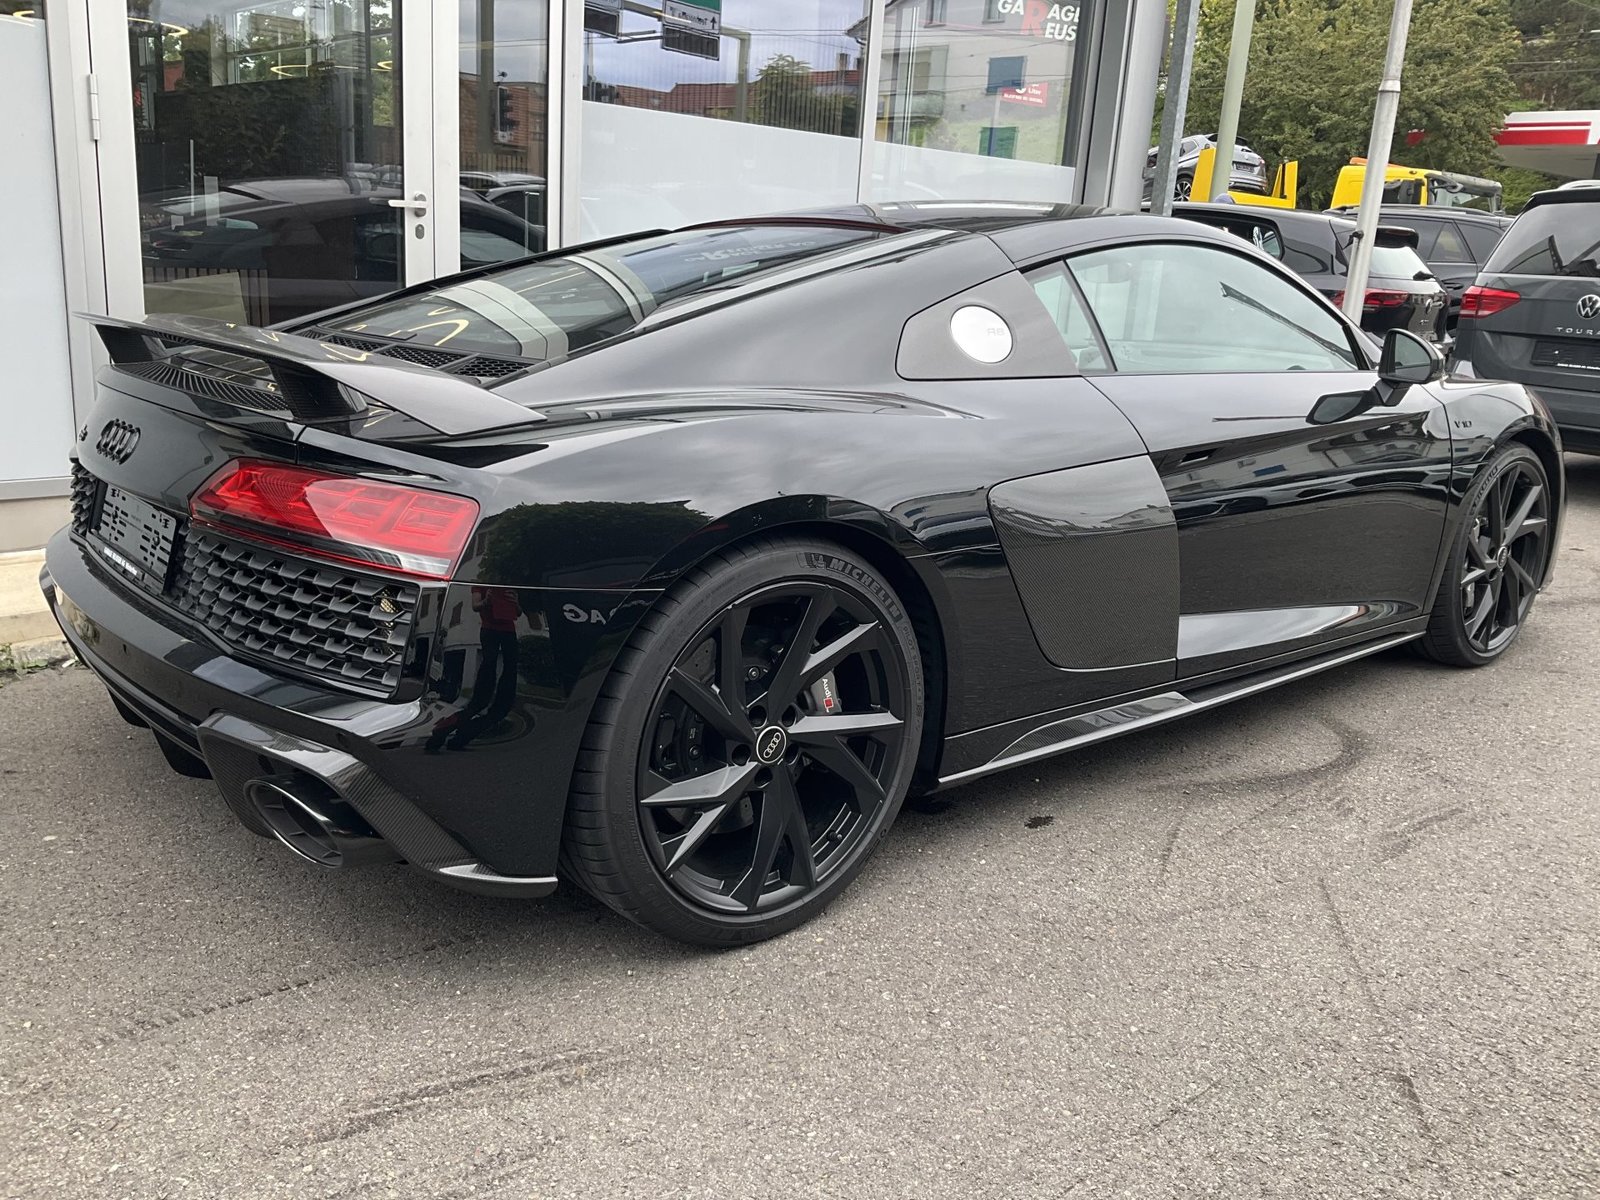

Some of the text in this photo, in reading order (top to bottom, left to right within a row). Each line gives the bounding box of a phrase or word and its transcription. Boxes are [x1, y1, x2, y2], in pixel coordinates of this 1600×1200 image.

[986, 327, 1005, 336] R8
[829, 557, 901, 618] MICHELIN
[822, 678, 832, 699] Audi
